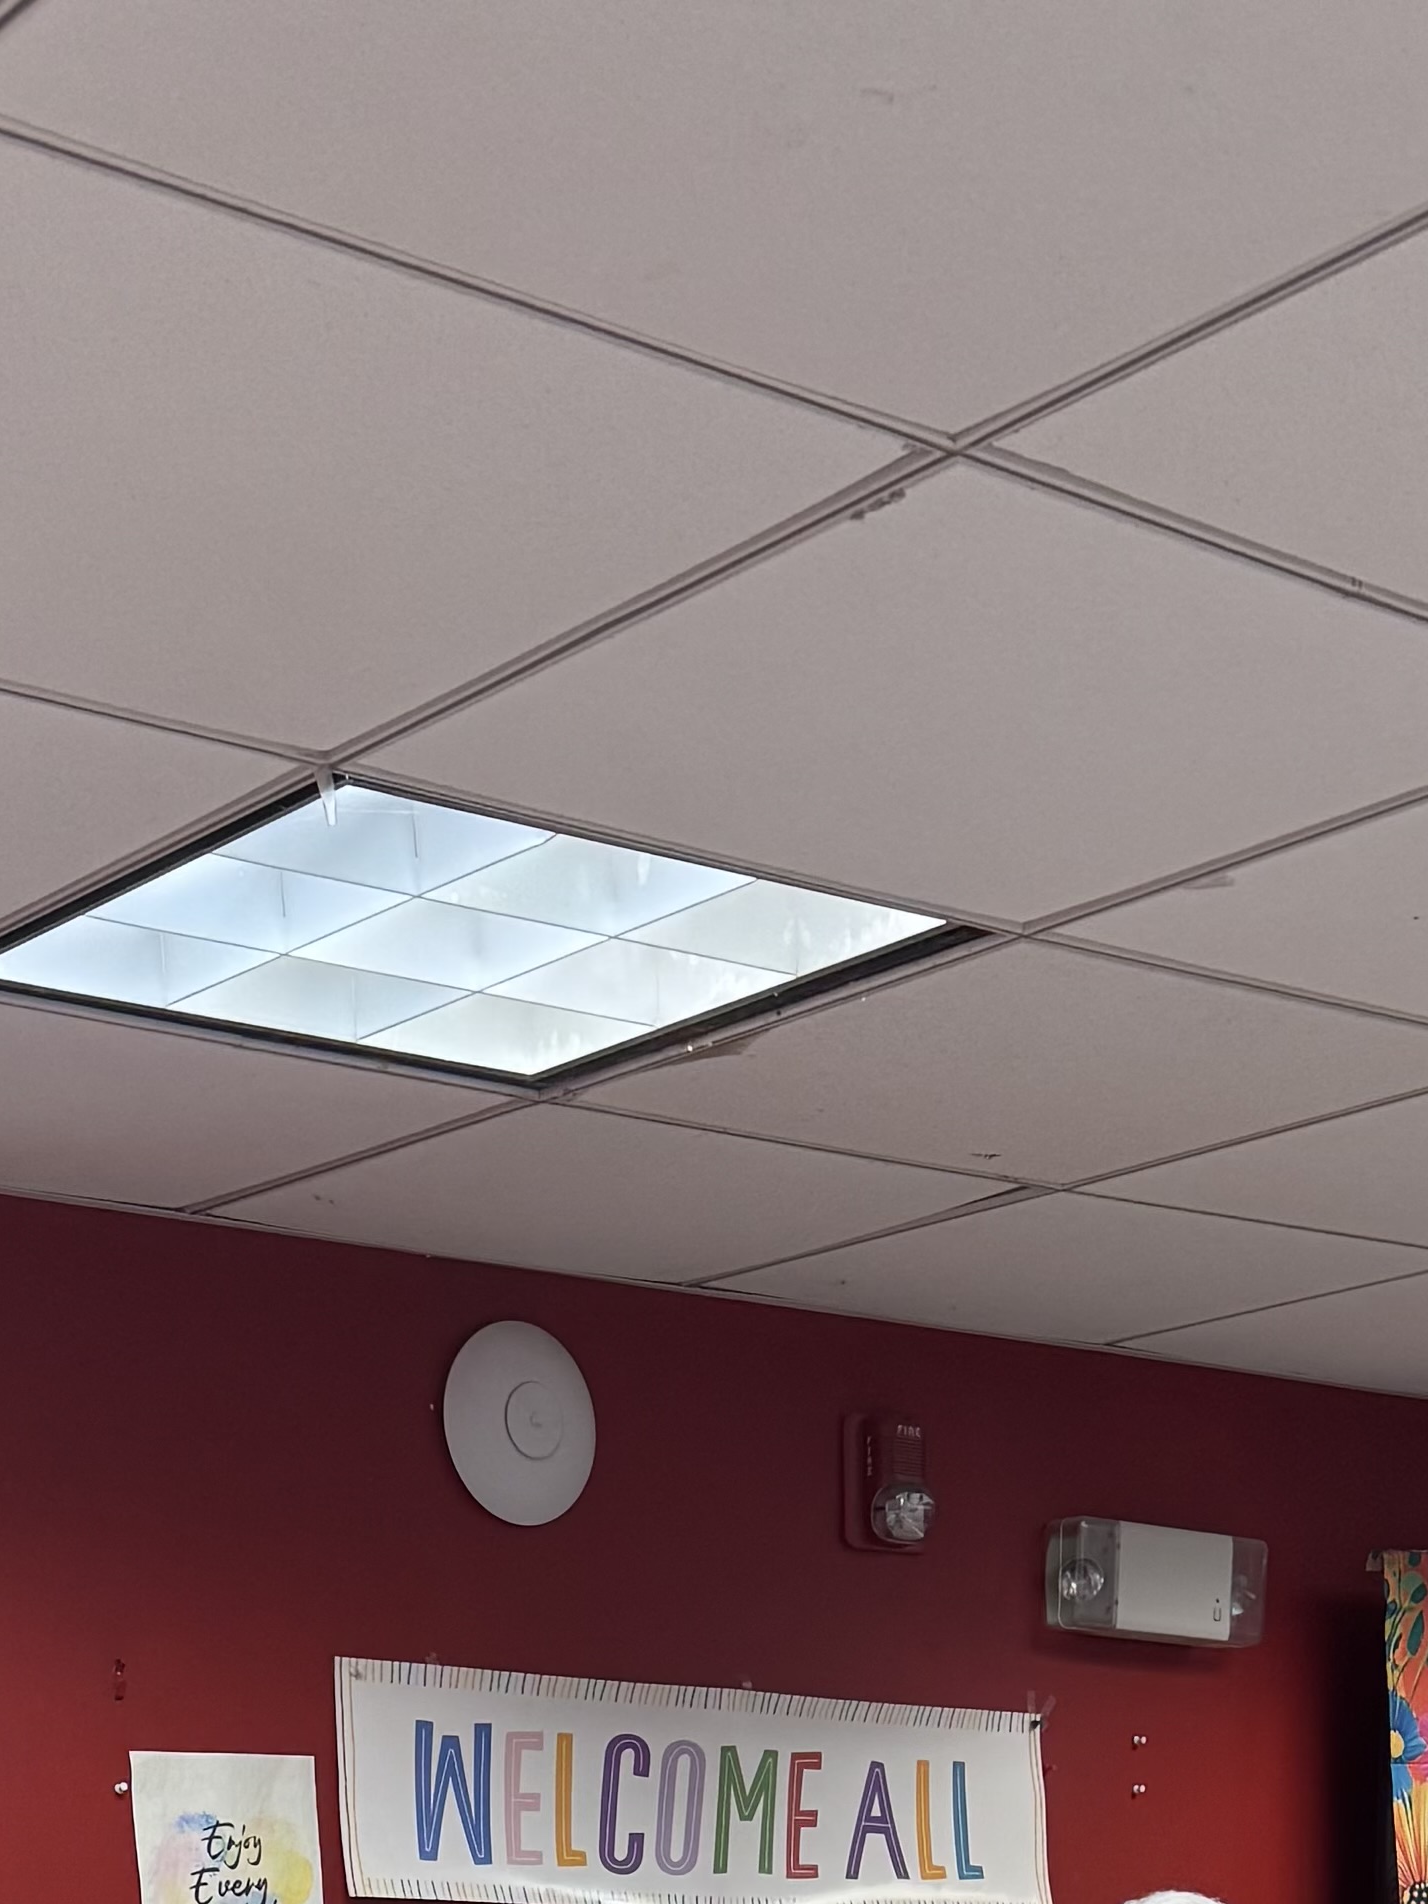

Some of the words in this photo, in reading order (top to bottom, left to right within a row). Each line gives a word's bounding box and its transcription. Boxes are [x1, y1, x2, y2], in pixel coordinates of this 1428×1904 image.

[200, 1820, 262, 1870] Enjoy
[415, 1719, 823, 1880] WELCOME
[845, 1759, 985, 1880] ALL
